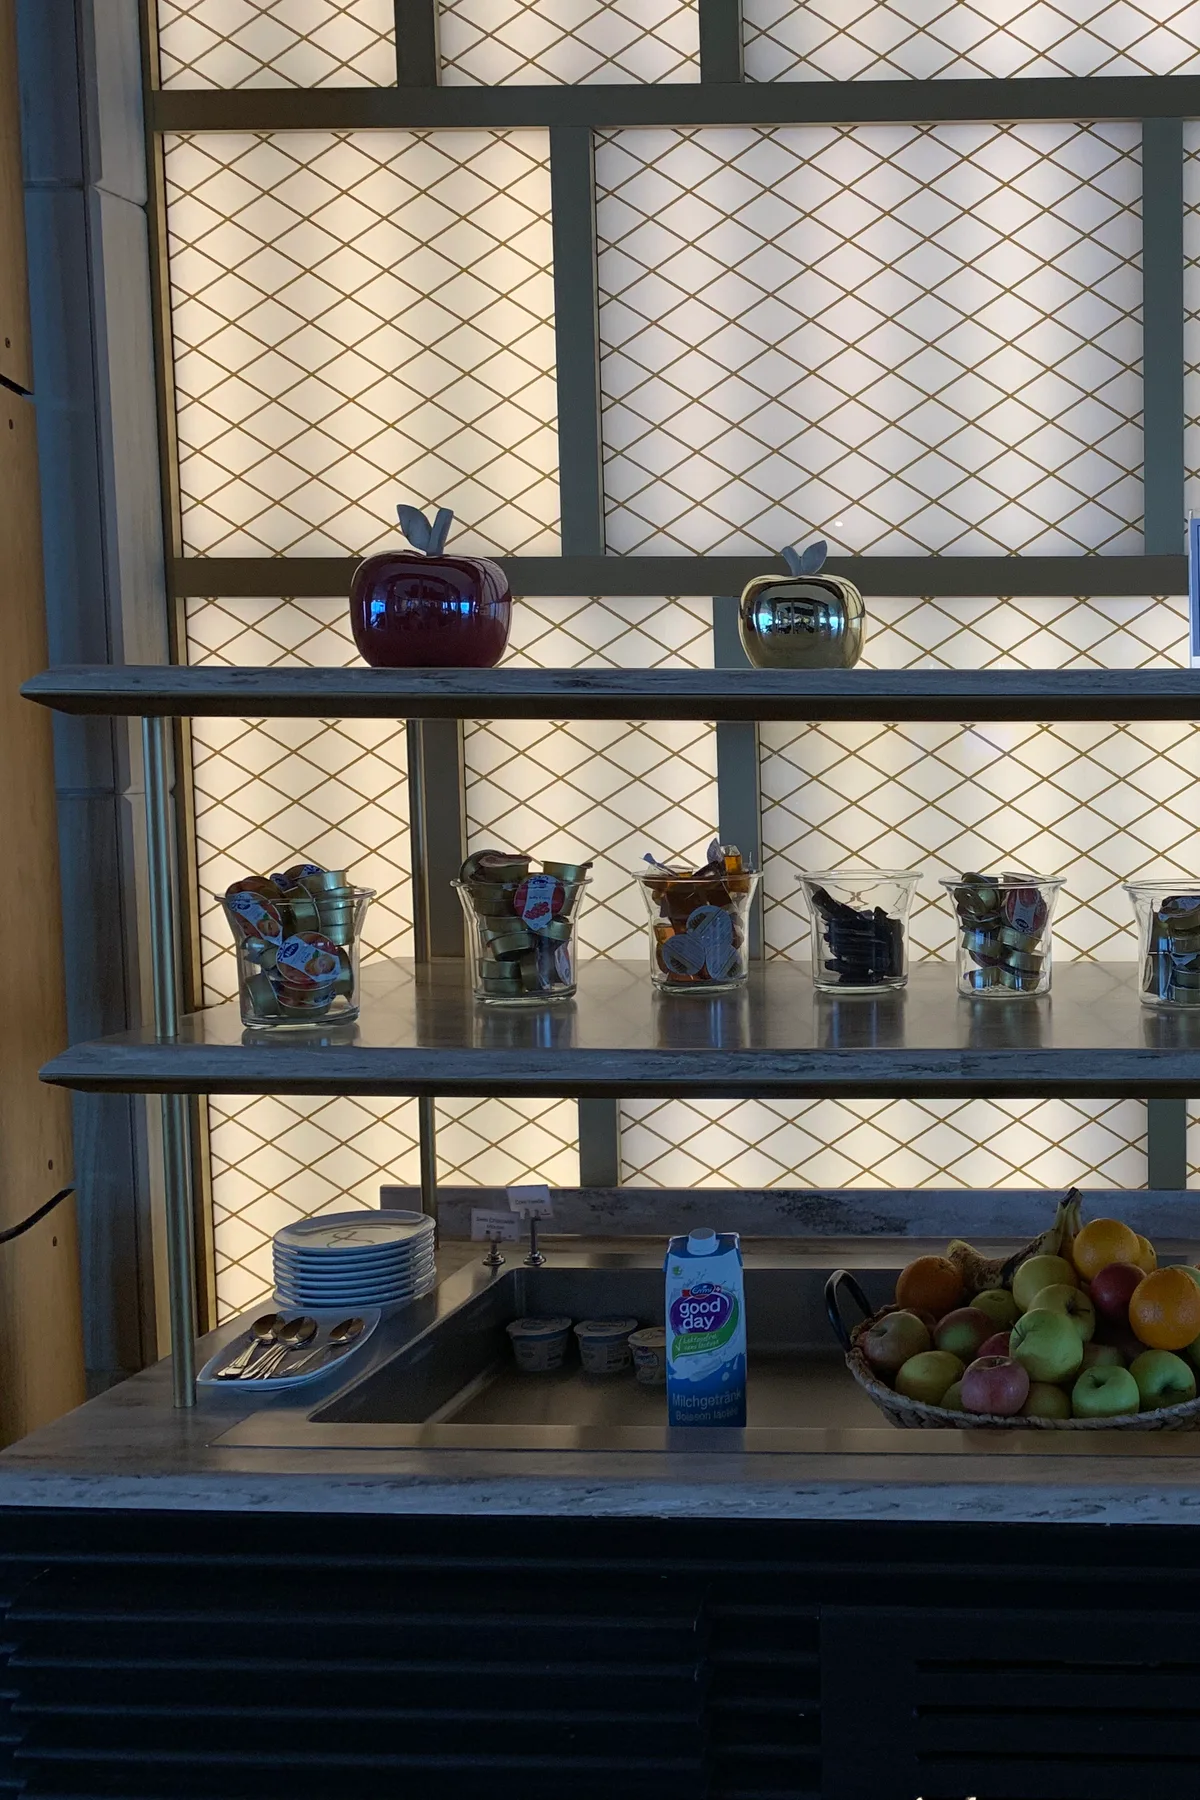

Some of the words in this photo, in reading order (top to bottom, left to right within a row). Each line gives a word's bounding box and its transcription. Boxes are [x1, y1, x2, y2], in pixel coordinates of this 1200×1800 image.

[679, 1297, 720, 1318] good
[682, 1314, 714, 1330] day
[672, 1387, 741, 1410] Milchgetränk
[676, 1410, 711, 1420] Boisson
